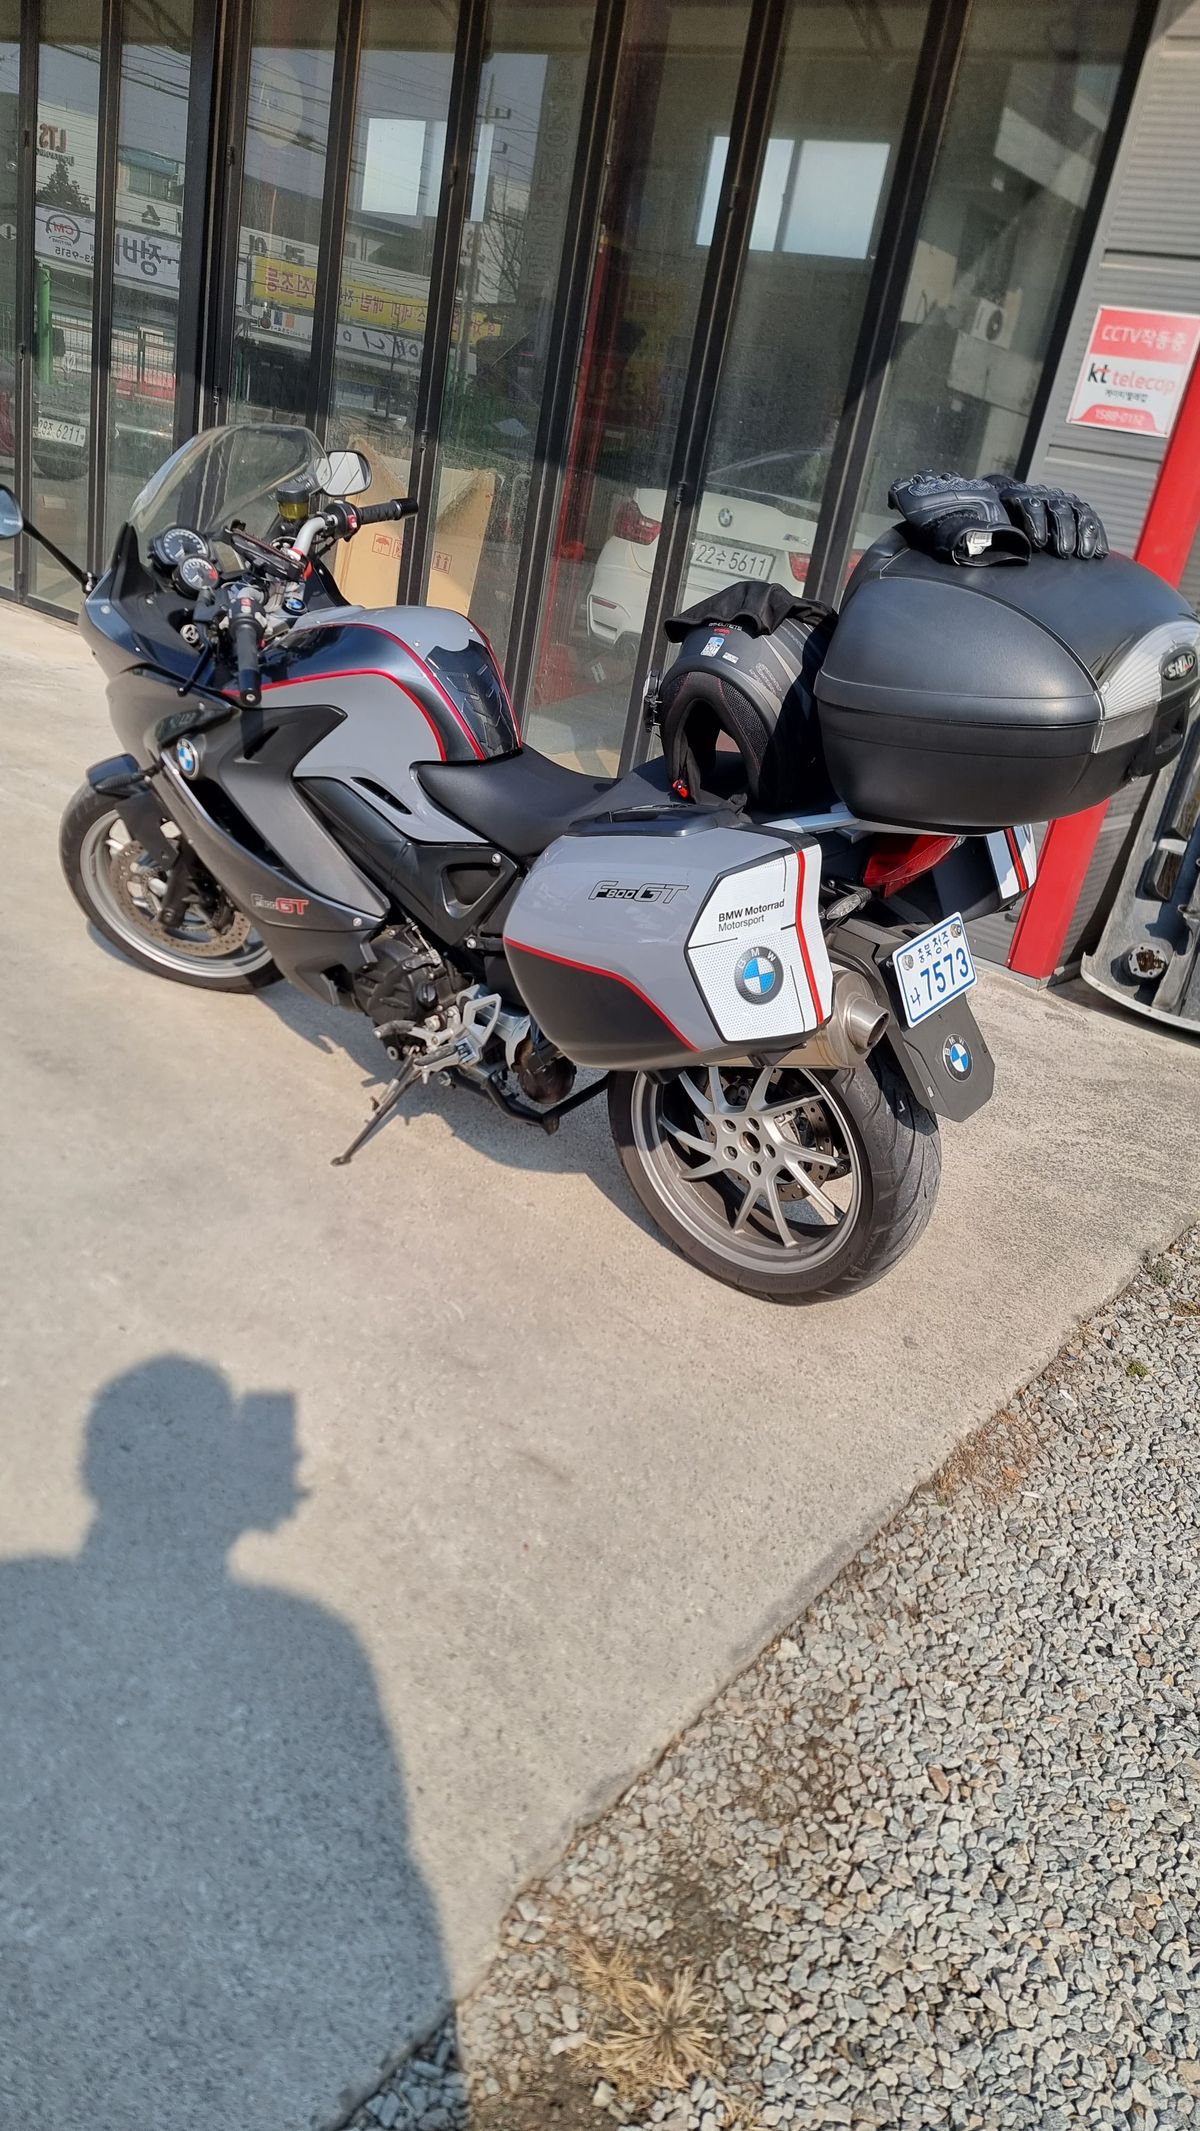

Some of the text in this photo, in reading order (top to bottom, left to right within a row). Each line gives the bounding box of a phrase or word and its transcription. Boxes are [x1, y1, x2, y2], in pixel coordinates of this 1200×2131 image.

[1101, 324, 1187, 352] CCTV작동중
[1087, 362, 1110, 384] kt
[56, 424, 80, 443] 6211
[695, 544, 767, 577] 22수 5611
[1167, 654, 1194, 679] SHAD
[588, 880, 689, 904] F800GT
[718, 898, 785, 922] BMW Motorrad
[718, 914, 765, 932] Motorsport
[910, 947, 969, 1007] 나 7573
